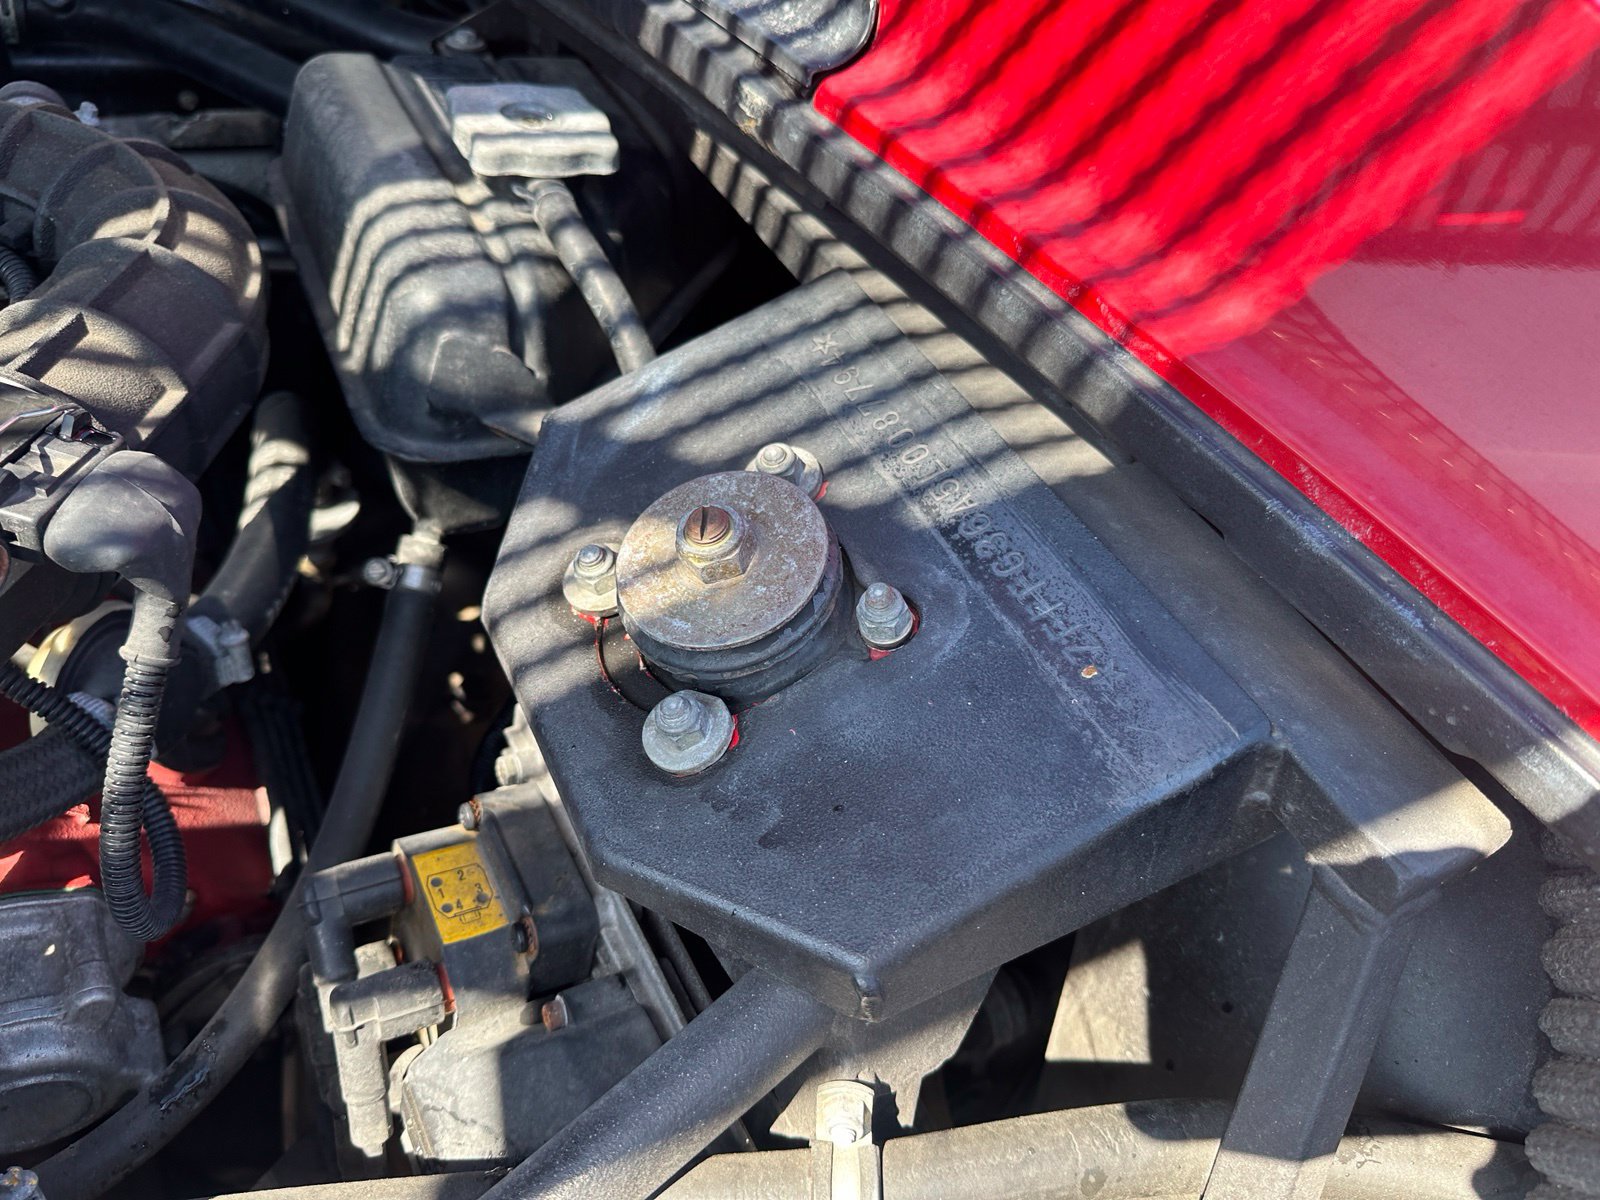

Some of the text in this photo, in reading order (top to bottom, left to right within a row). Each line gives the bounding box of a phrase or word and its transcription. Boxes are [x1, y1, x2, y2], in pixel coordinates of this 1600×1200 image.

[457, 870, 466, 881] 2
[438, 888, 445, 899] 1
[456, 899, 464, 910] 4
